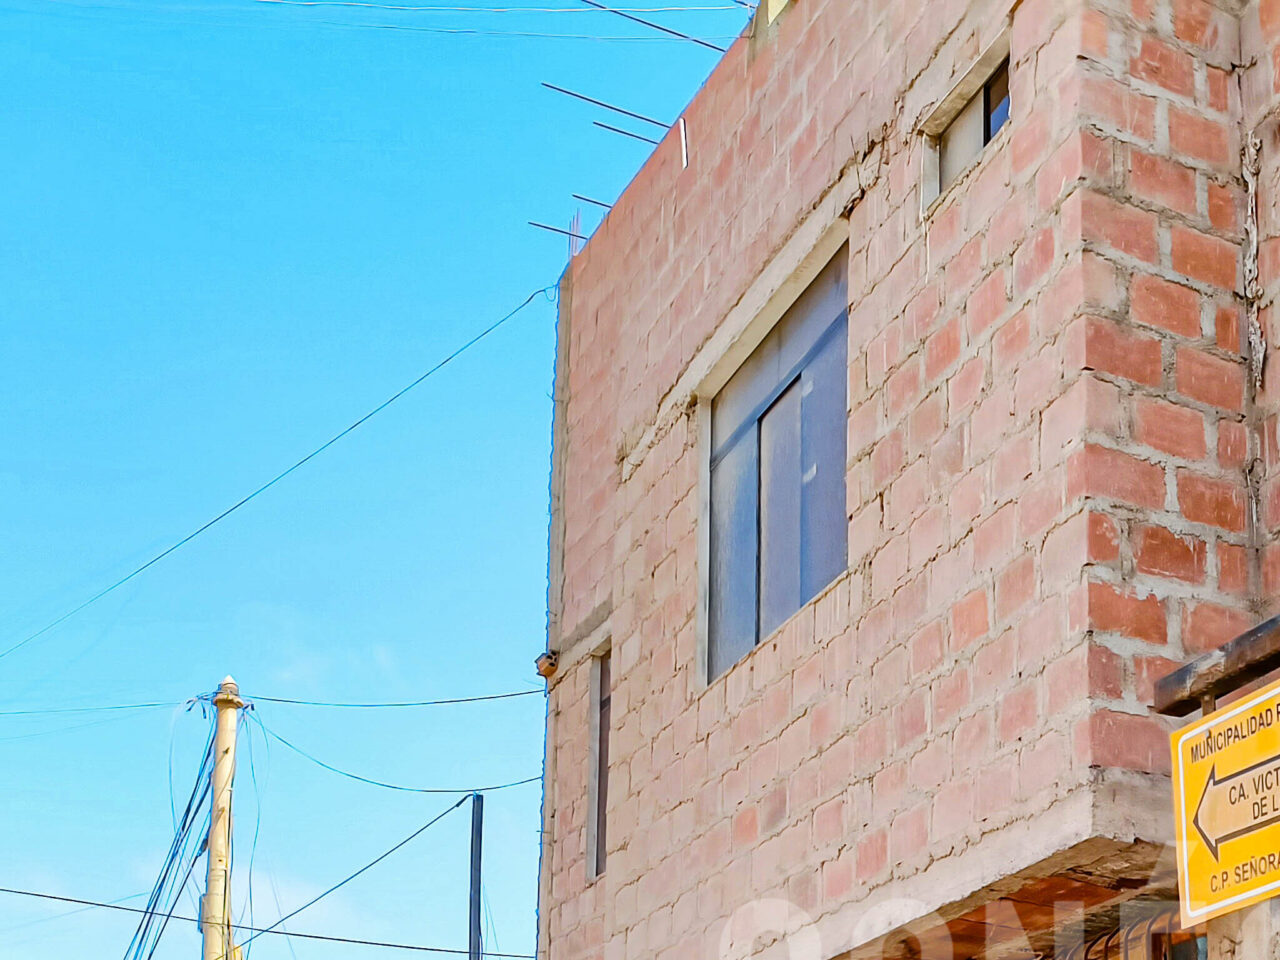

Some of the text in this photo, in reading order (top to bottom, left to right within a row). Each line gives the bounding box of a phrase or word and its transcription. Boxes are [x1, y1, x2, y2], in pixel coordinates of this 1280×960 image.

[1191, 708, 1273, 763] MUNICIPALIDAD
[1229, 781, 1249, 805] CA.
[1252, 799, 1268, 820] DE
